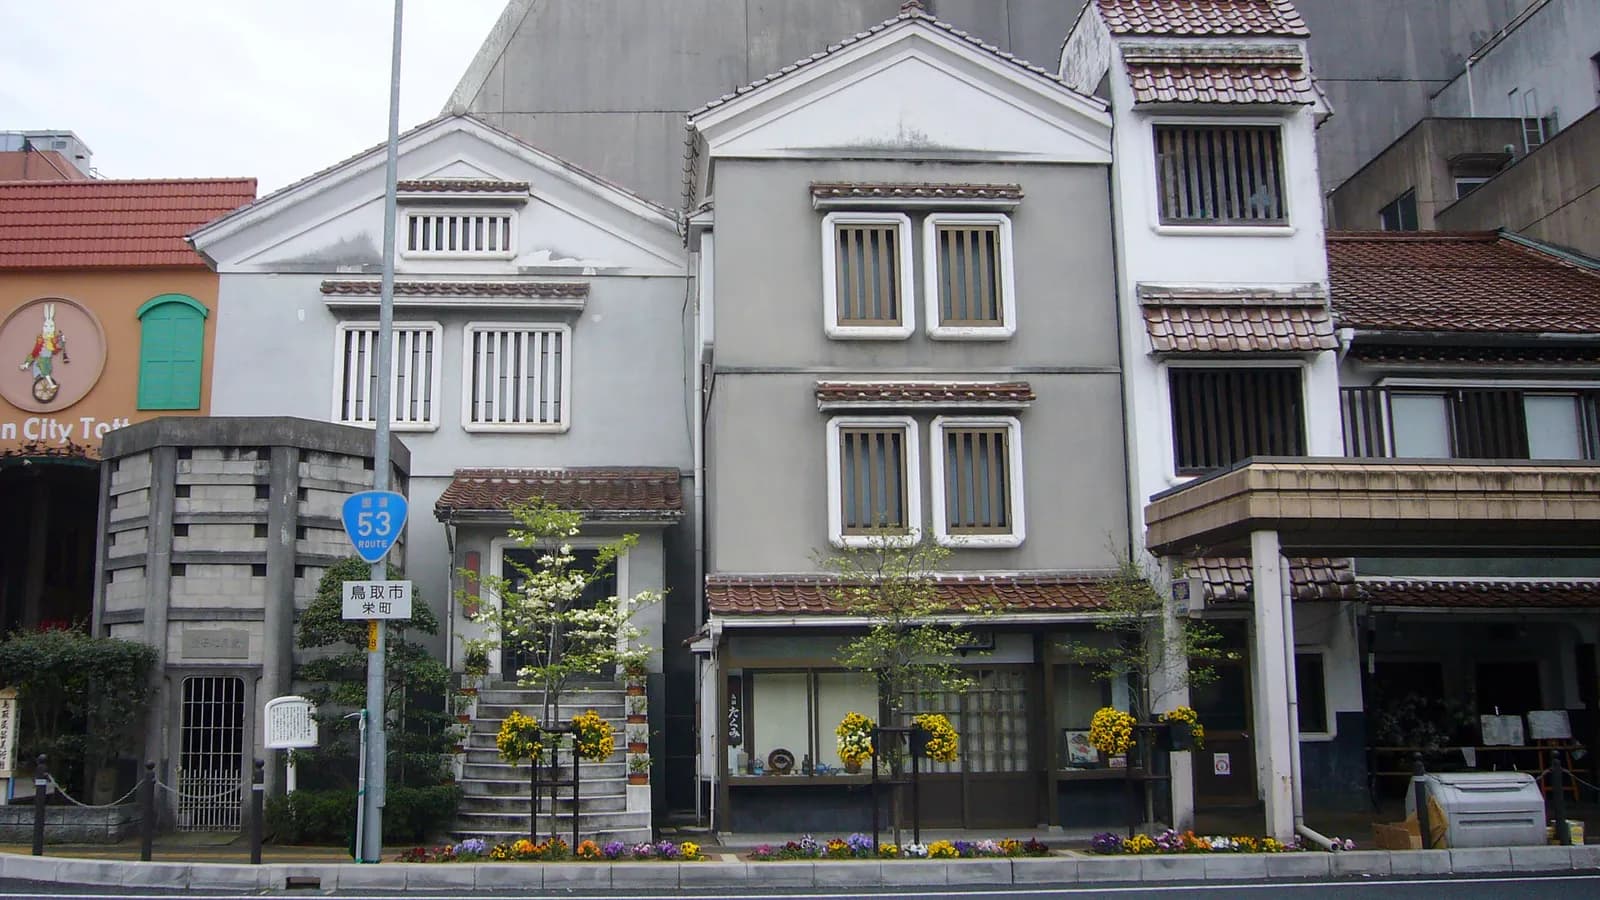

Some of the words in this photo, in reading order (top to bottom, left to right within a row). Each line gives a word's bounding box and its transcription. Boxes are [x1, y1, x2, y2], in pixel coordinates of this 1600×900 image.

[23, 417, 73, 444] City
[358, 511, 391, 537] 53
[358, 540, 388, 549] ROUTE
[351, 585, 404, 600] 鳥取市
[362, 602, 392, 614] 栄町
